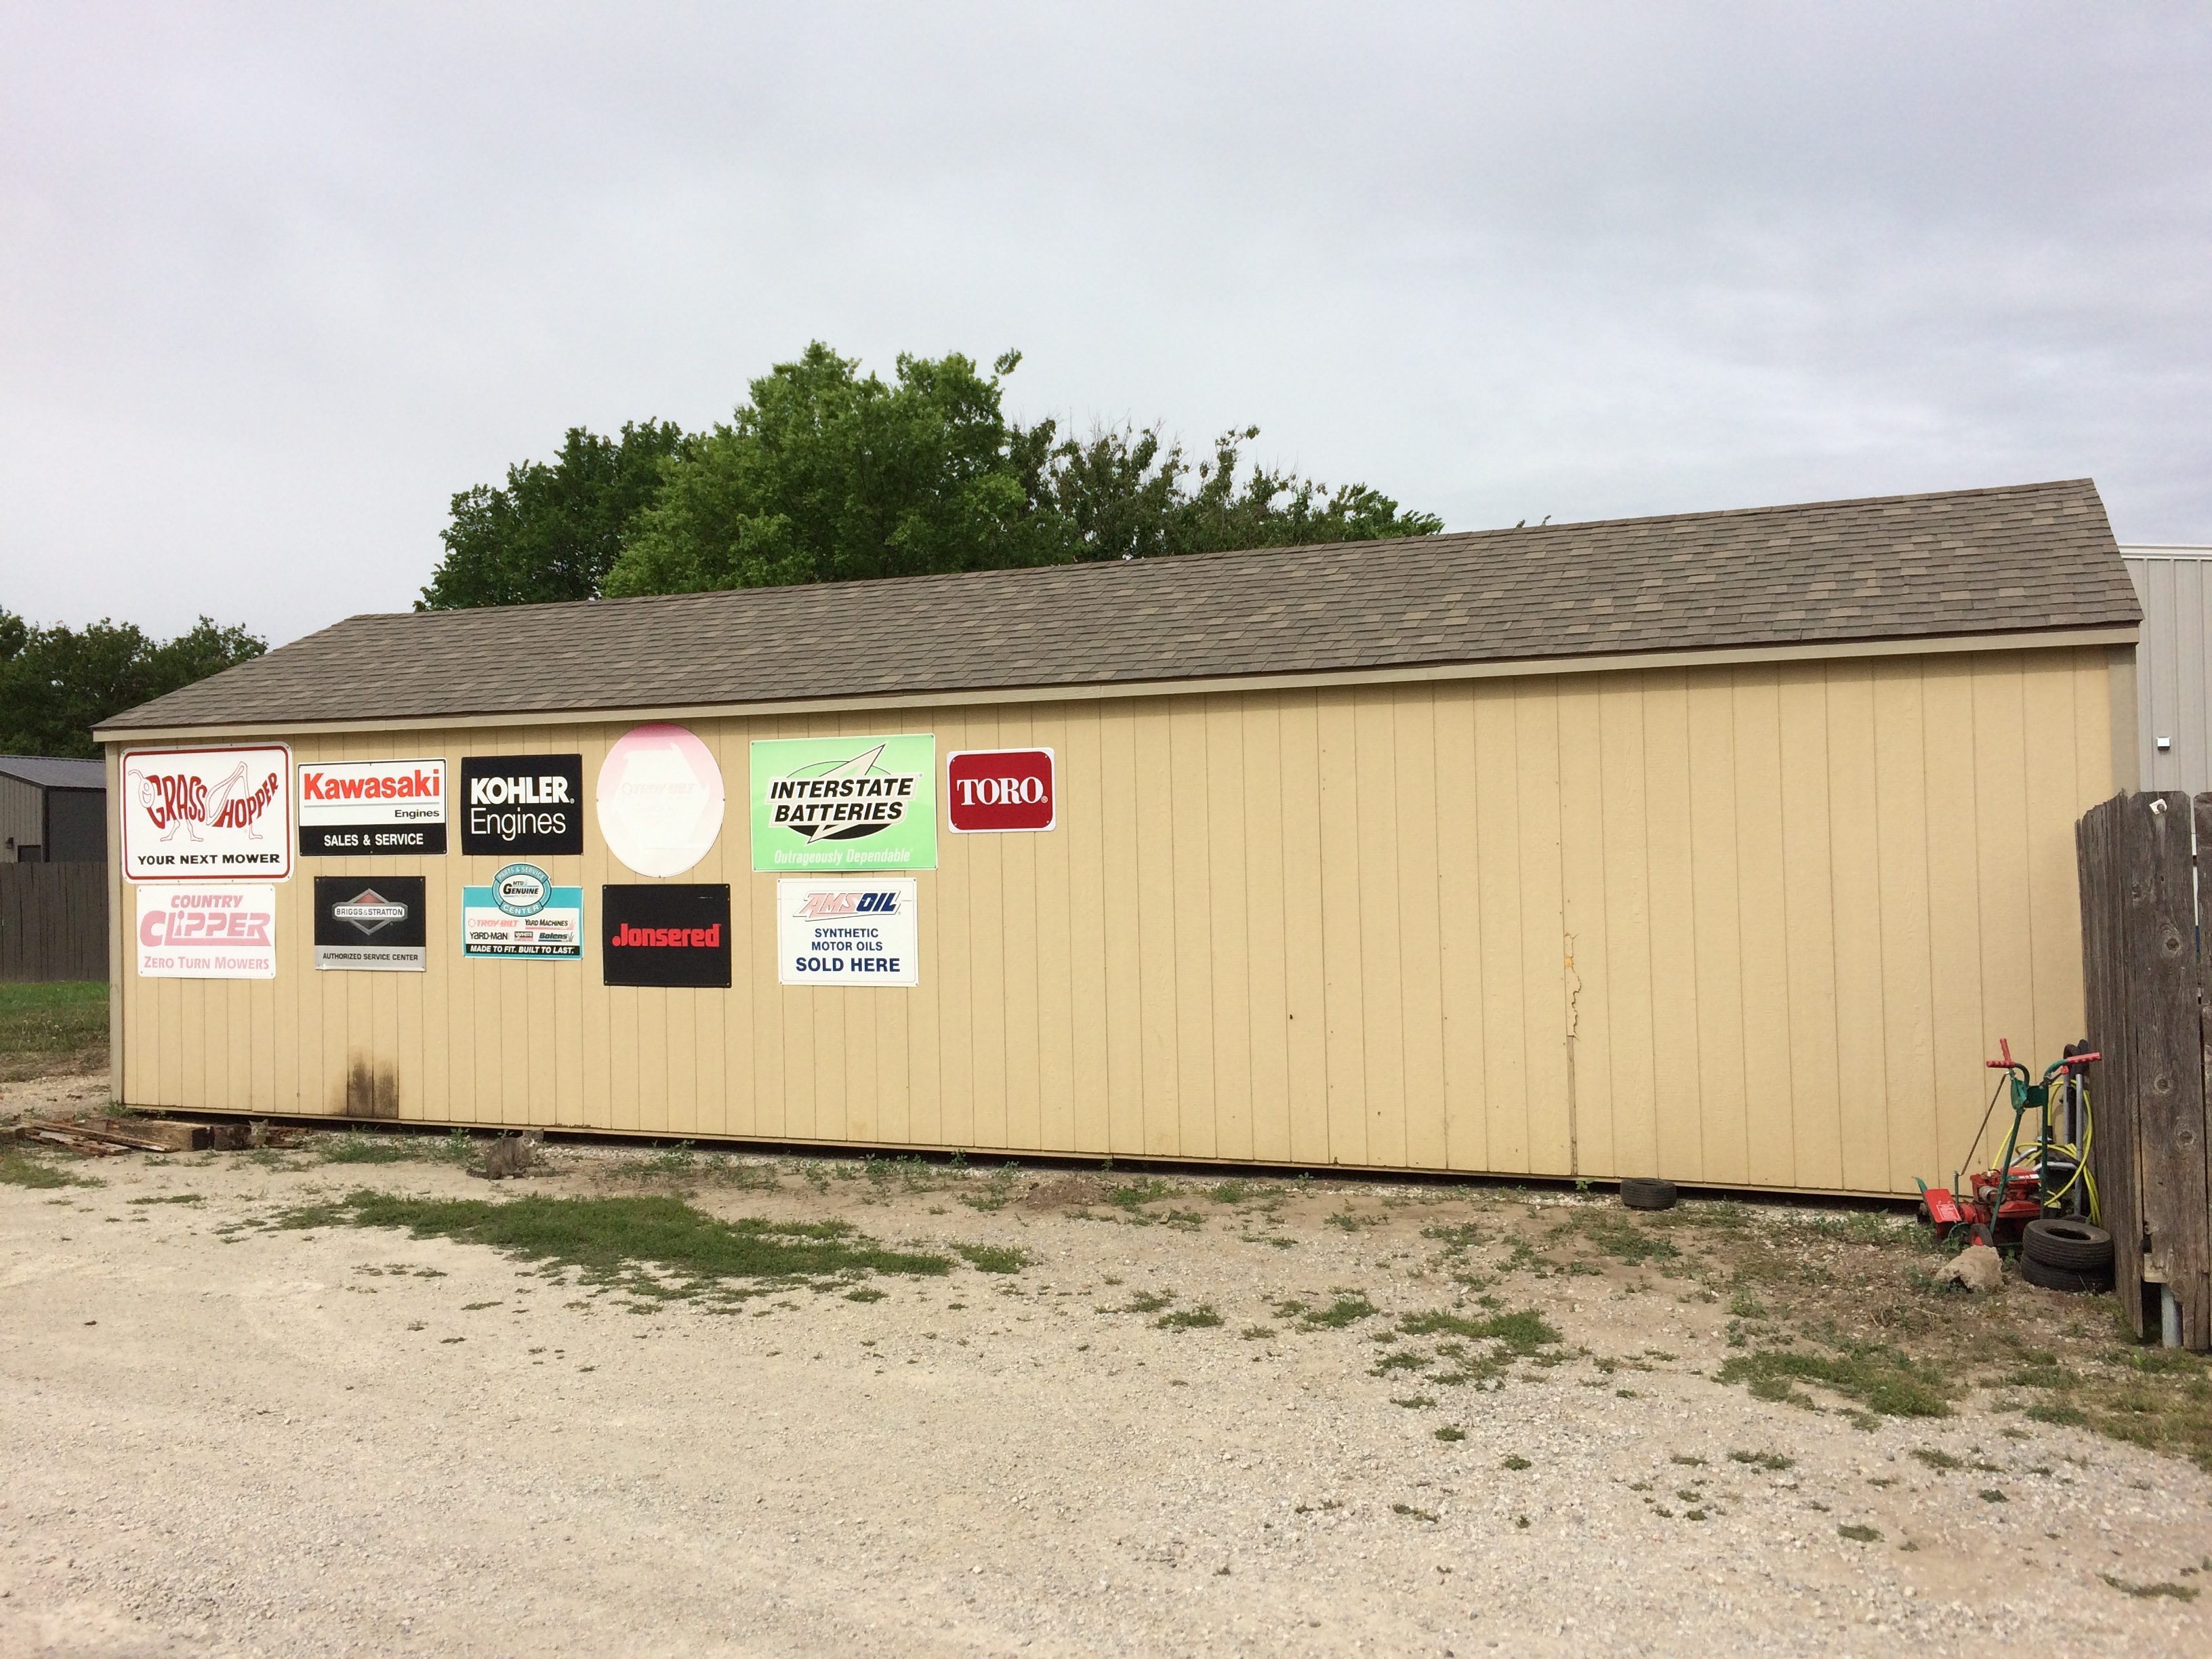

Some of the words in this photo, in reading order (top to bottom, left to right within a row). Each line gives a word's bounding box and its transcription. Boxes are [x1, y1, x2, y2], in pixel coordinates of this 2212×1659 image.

[304, 769, 439, 800] Kawasaki
[471, 776, 570, 804] KOHLER
[771, 777, 914, 799] INTERSTATE
[957, 777, 1044, 805] TORO
[142, 774, 207, 829] GRASS
[211, 773, 279, 828] HOPPER
[394, 809, 440, 819] Engines
[775, 802, 903, 822] BATTERIES
[471, 807, 566, 841] Engines
[324, 834, 359, 846] SALES
[363, 834, 371, 846] &
[375, 834, 424, 845] SERVICE
[138, 855, 175, 865] YOUR
[180, 855, 218, 864] NEXT
[222, 854, 280, 863] MOWER
[774, 849, 843, 866] Outrageously
[846, 848, 910, 865] Dependable
[498, 867, 514, 880] PARTS
[521, 867, 545, 880] SERVICE
[504, 883, 539, 895] GENUINE
[171, 895, 243, 907] COUNTRY
[799, 893, 897, 918] AMSOIL
[504, 904, 539, 915] CENTER
[612, 923, 721, 947] Jonsered
[815, 928, 879, 938] SYNTHETIC
[811, 941, 853, 951] MOTOR
[857, 941, 883, 951] OILS
[144, 956, 174, 968] ZERO
[178, 956, 210, 969] TURN
[214, 957, 269, 969] MOWERS
[796, 957, 844, 972] SOLD
[851, 958, 900, 972] HERE
